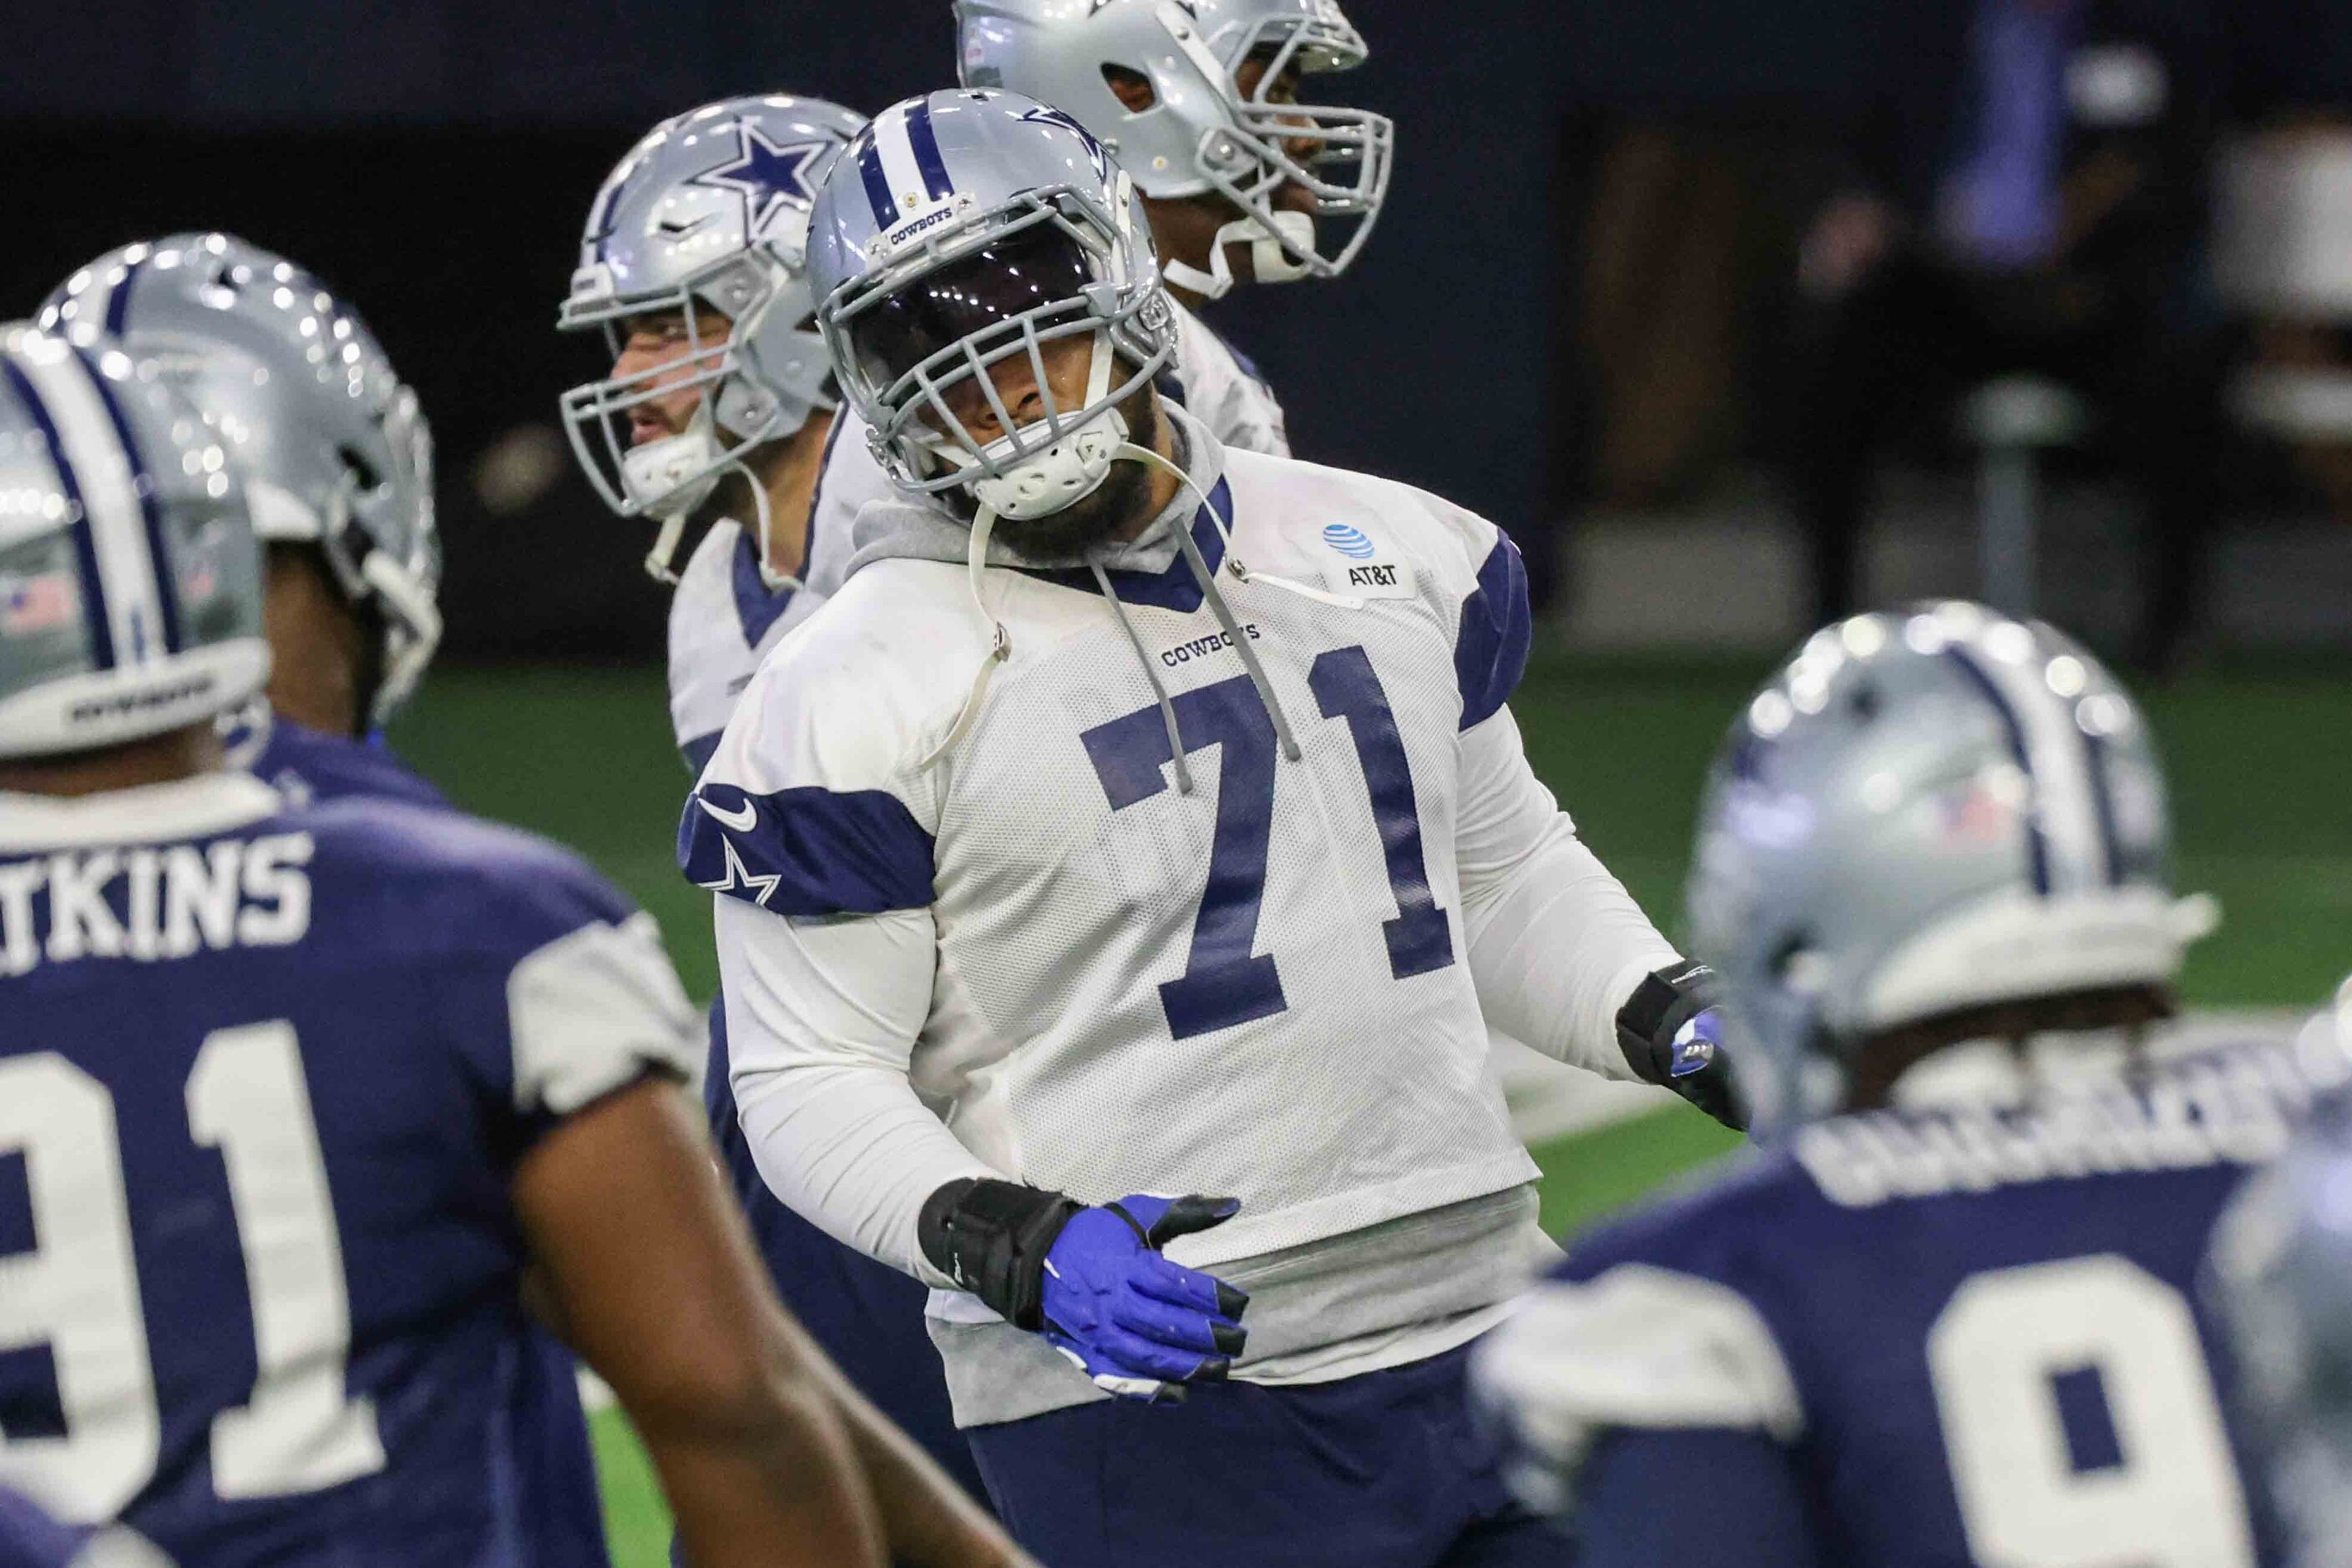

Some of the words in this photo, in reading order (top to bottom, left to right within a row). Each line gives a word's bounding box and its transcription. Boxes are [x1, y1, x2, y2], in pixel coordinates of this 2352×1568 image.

[890, 207, 953, 245] COWBOYS
[1348, 564, 1397, 586] AT&T
[1161, 623, 1261, 667] COWBOS
[1080, 645, 1455, 1041] 71
